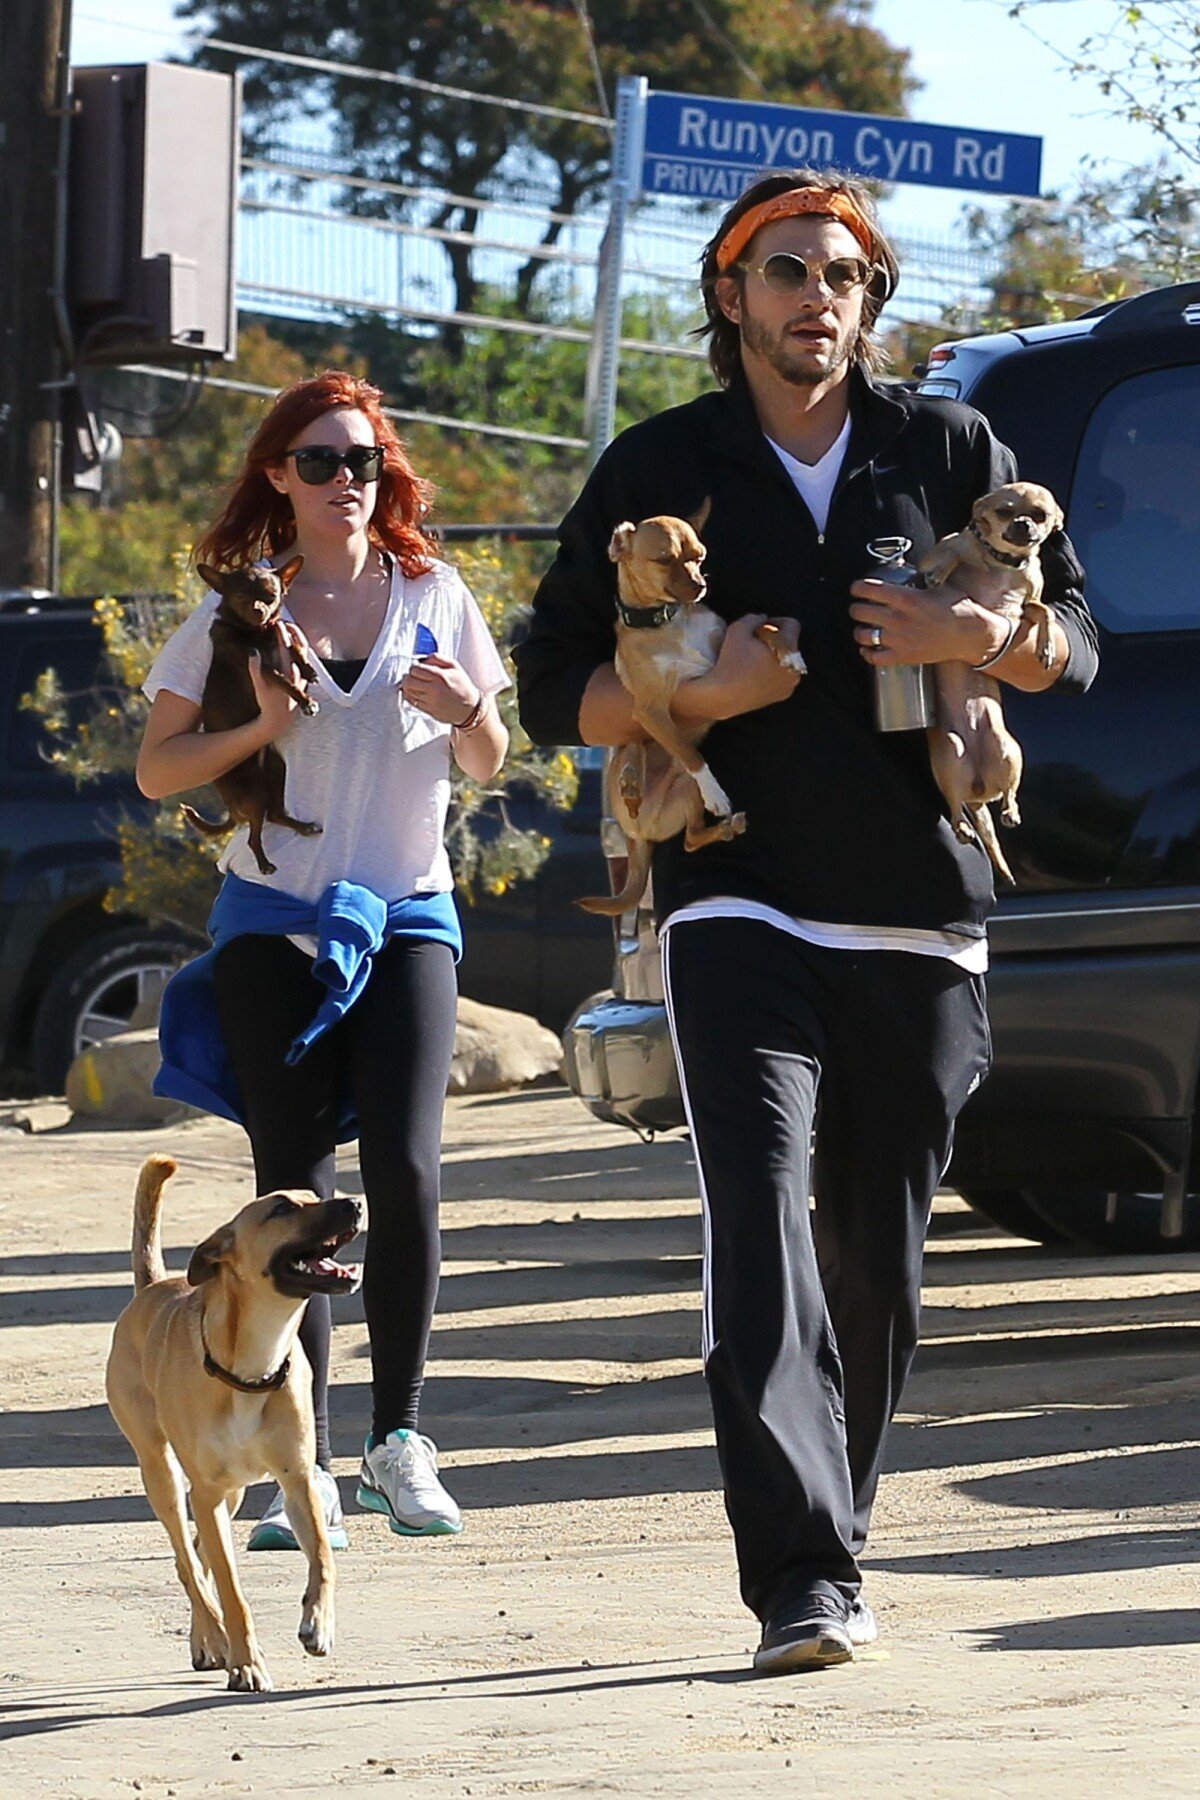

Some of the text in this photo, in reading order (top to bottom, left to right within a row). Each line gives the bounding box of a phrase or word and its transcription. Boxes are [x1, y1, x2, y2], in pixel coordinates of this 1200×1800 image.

[678, 106, 1006, 182] Runyon Cyn Rd
